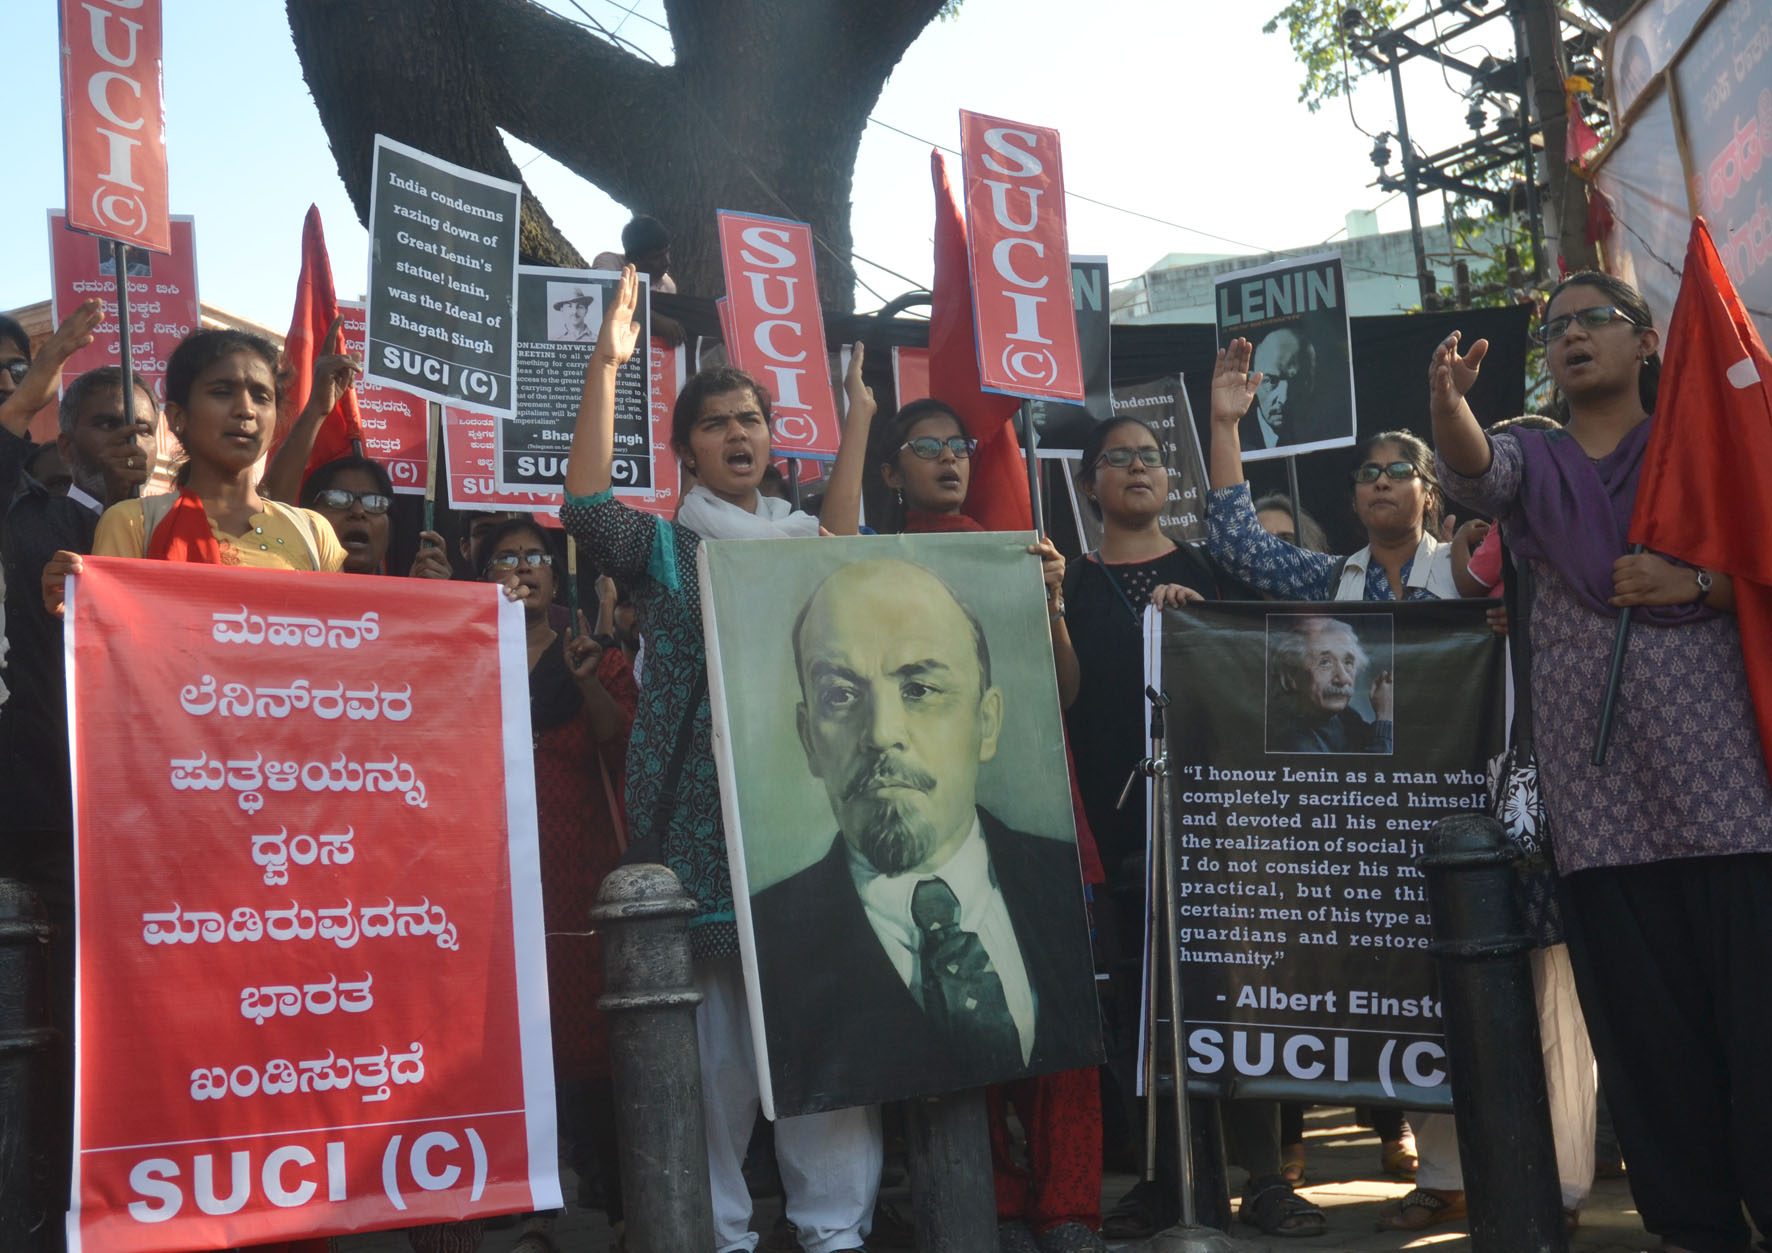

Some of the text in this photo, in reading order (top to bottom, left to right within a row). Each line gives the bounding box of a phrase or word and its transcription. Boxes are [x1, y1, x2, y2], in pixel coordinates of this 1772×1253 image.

[80, 0, 144, 192] UCI
[389, 173, 504, 222] India condemns
[393, 205, 498, 248] razing down of
[981, 128, 1052, 344] SUCI
[397, 232, 492, 272] Great Lenin's
[396, 262, 489, 300] statue! lenin,
[388, 286, 502, 328] was the Ideal of
[1220, 266, 1336, 327] LENIN
[740, 227, 812, 409] SUCI
[390, 312, 494, 353] Bhagath Singh
[384, 347, 498, 400] SUCI (C)
[1113, 394, 1174, 409] ondemns
[1162, 417, 1175, 427] of
[615, 433, 643, 445] ingh
[387, 461, 418, 483] (C)
[611, 460, 638, 484] C)
[1185, 488, 1197, 498] of
[1160, 513, 1198, 526] Singh
[212, 604, 380, 649] ಮಹಾನ್
[1209, 766, 1276, 782] honour
[1282, 768, 1339, 782] Lenin
[1346, 772, 1367, 783] as
[1375, 772, 1386, 783] a
[1393, 773, 1437, 784] man
[1444, 770, 1485, 784] who
[1183, 790, 1487, 808] completely sacrificed himself
[1182, 812, 1216, 826] and
[1226, 812, 1302, 828] devoted
[1312, 814, 1336, 828] all
[1346, 815, 1376, 829] his
[1182, 834, 1211, 848] the
[1216, 836, 1320, 851] realization
[1324, 838, 1344, 852] of
[1347, 839, 1406, 854] social
[1181, 856, 1189, 870] I
[1198, 857, 1219, 872] do
[1228, 859, 1257, 873] not
[1266, 860, 1350, 875] consider
[1359, 861, 1388, 876] his
[1181, 881, 1424, 901] practical, but one thi
[1181, 903, 1255, 918] certain:
[1260, 908, 1302, 920] men
[1308, 907, 1327, 921] of
[1331, 908, 1360, 922] his
[1366, 909, 1409, 928] type
[1181, 927, 1430, 948] guardians and restore
[1180, 948, 1284, 969] humanity.”
[240, 970, 374, 1025] ಭಾರತ
[1236, 985, 1336, 1012] Albert
[1188, 1029, 1349, 1082] SUCI
[190, 1041, 425, 1103] ಖಂಡಿಸುತ್ತದೆ
[128, 1128, 488, 1222] SUCI (C)
